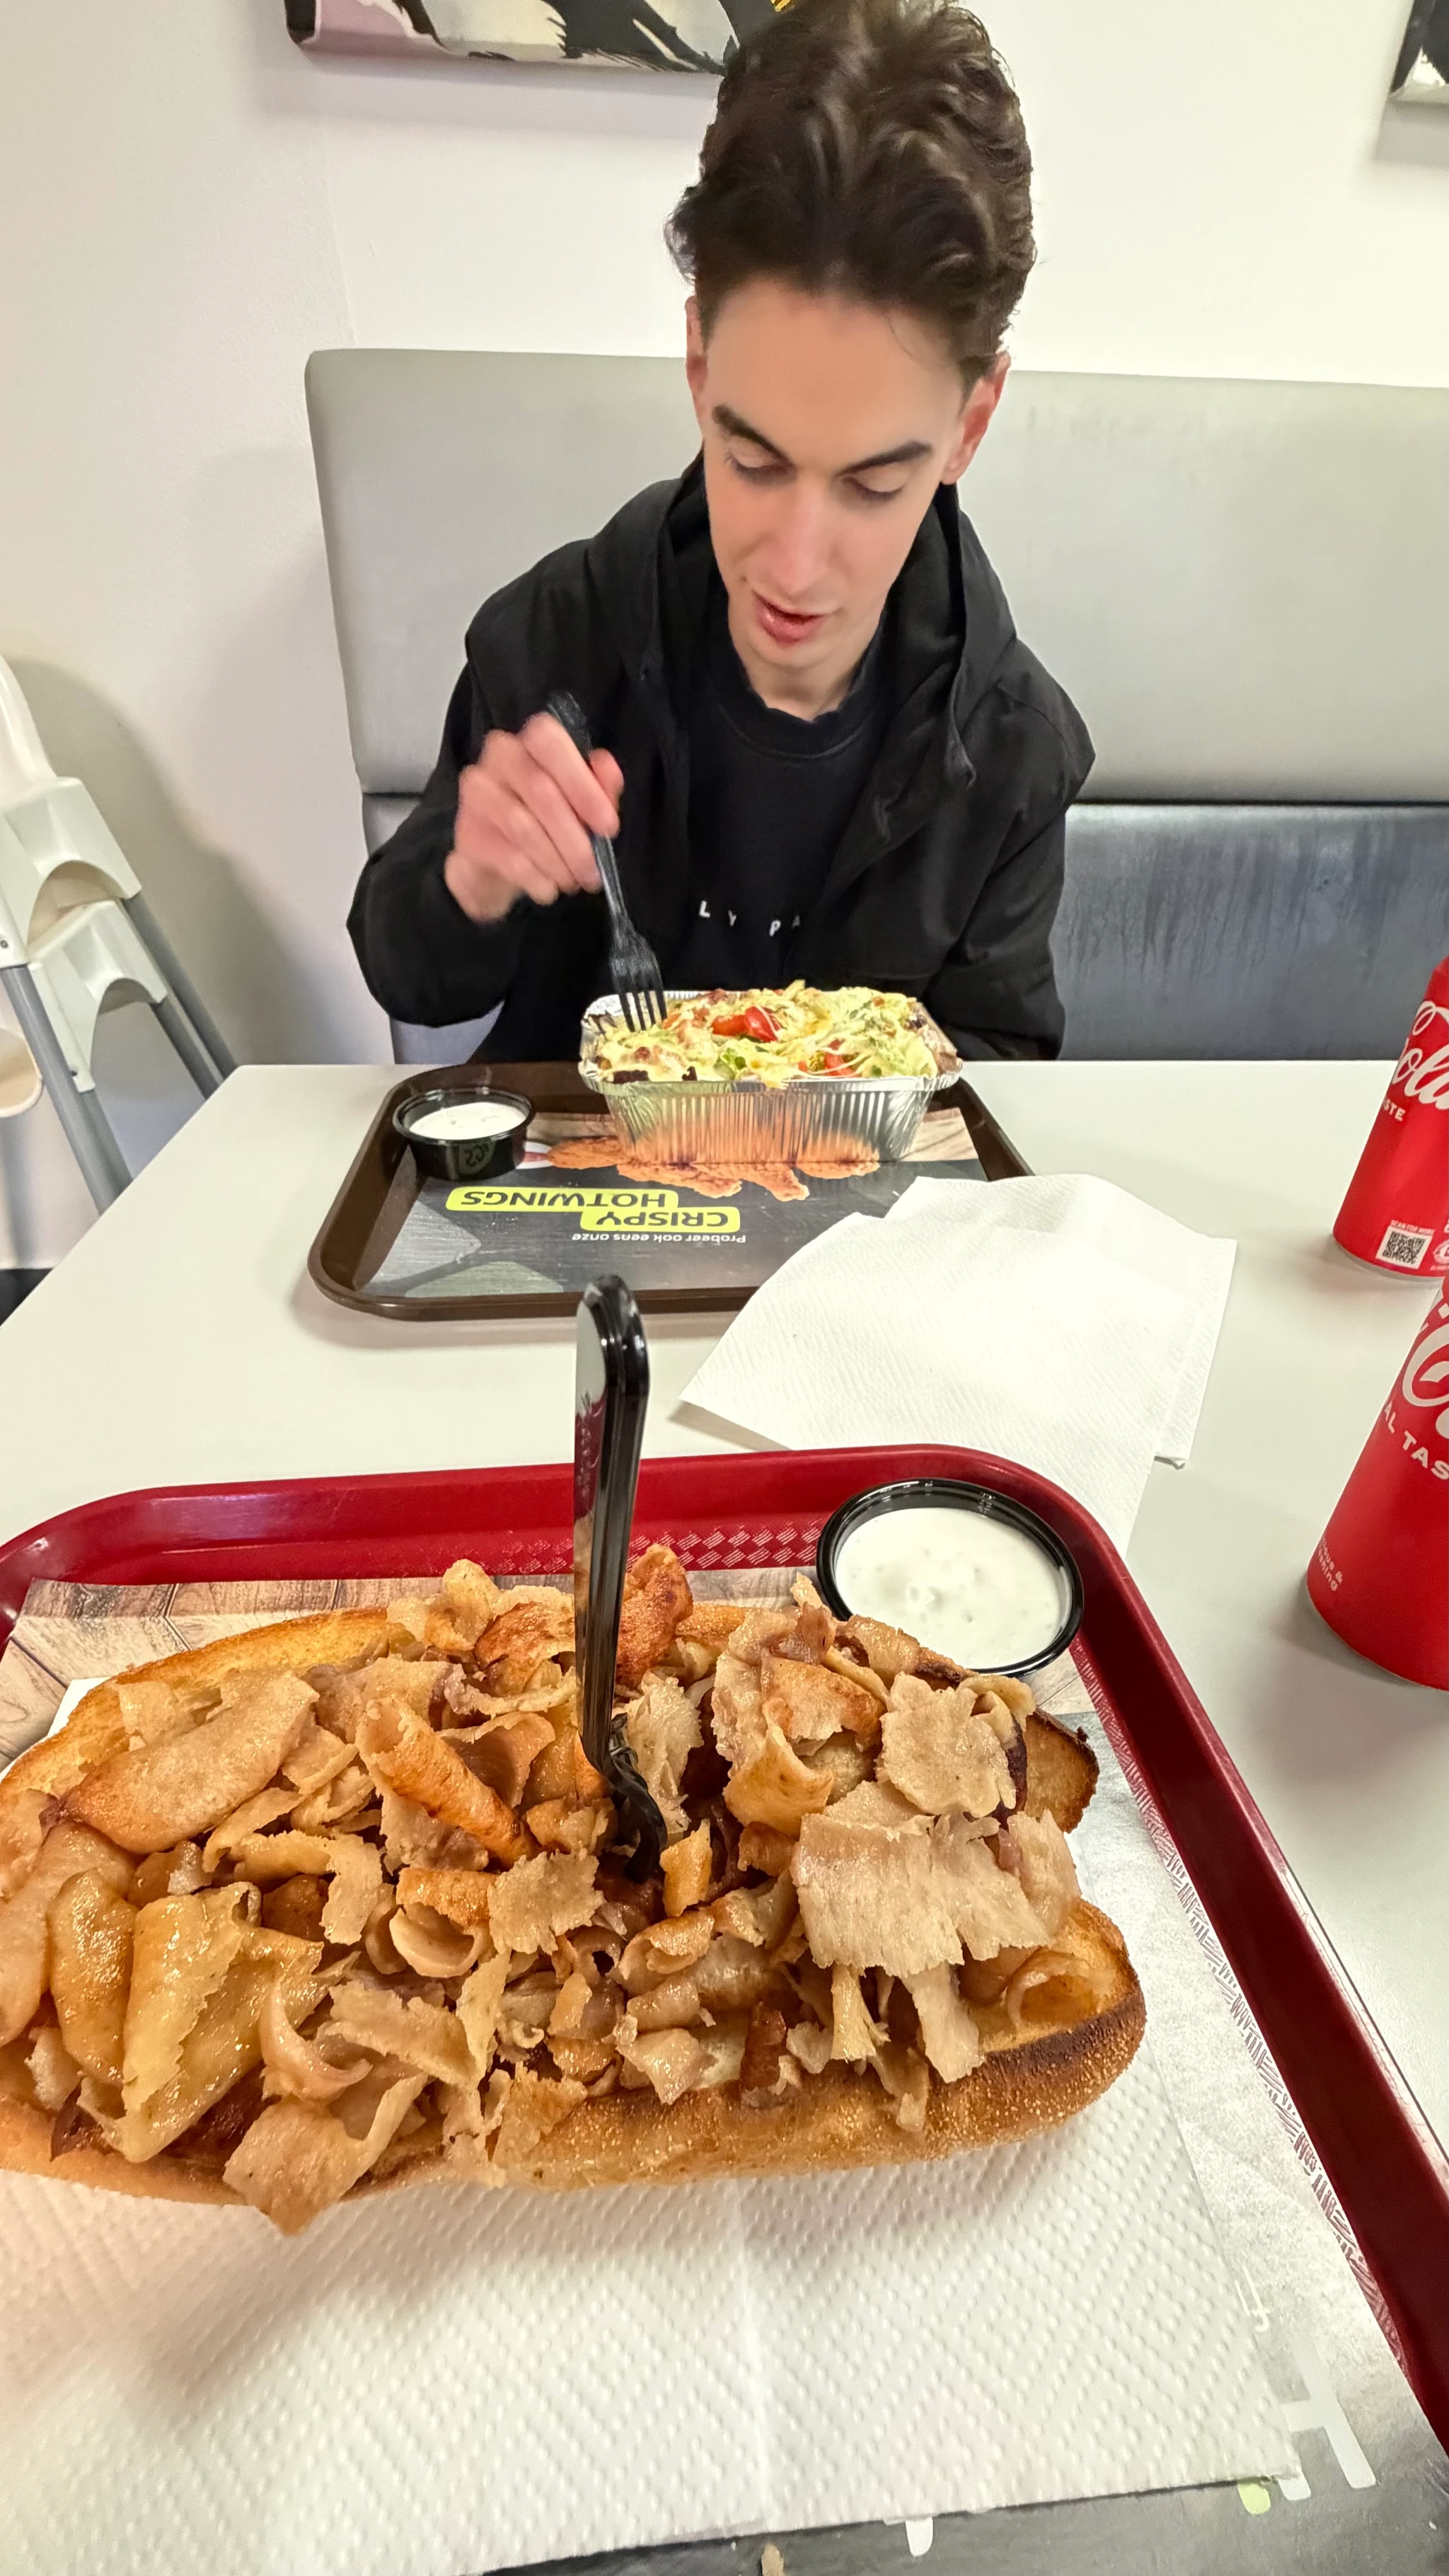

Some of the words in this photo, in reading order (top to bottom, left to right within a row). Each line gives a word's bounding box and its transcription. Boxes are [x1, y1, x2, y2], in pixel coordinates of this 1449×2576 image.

[1382, 1097, 1406, 1121] STE
[461, 1191, 666, 1208] HOTWINGS
[596, 1211, 729, 1228] CRISPY
[653, 1234, 683, 1243] ook
[685, 1234, 746, 1243] Probeer
